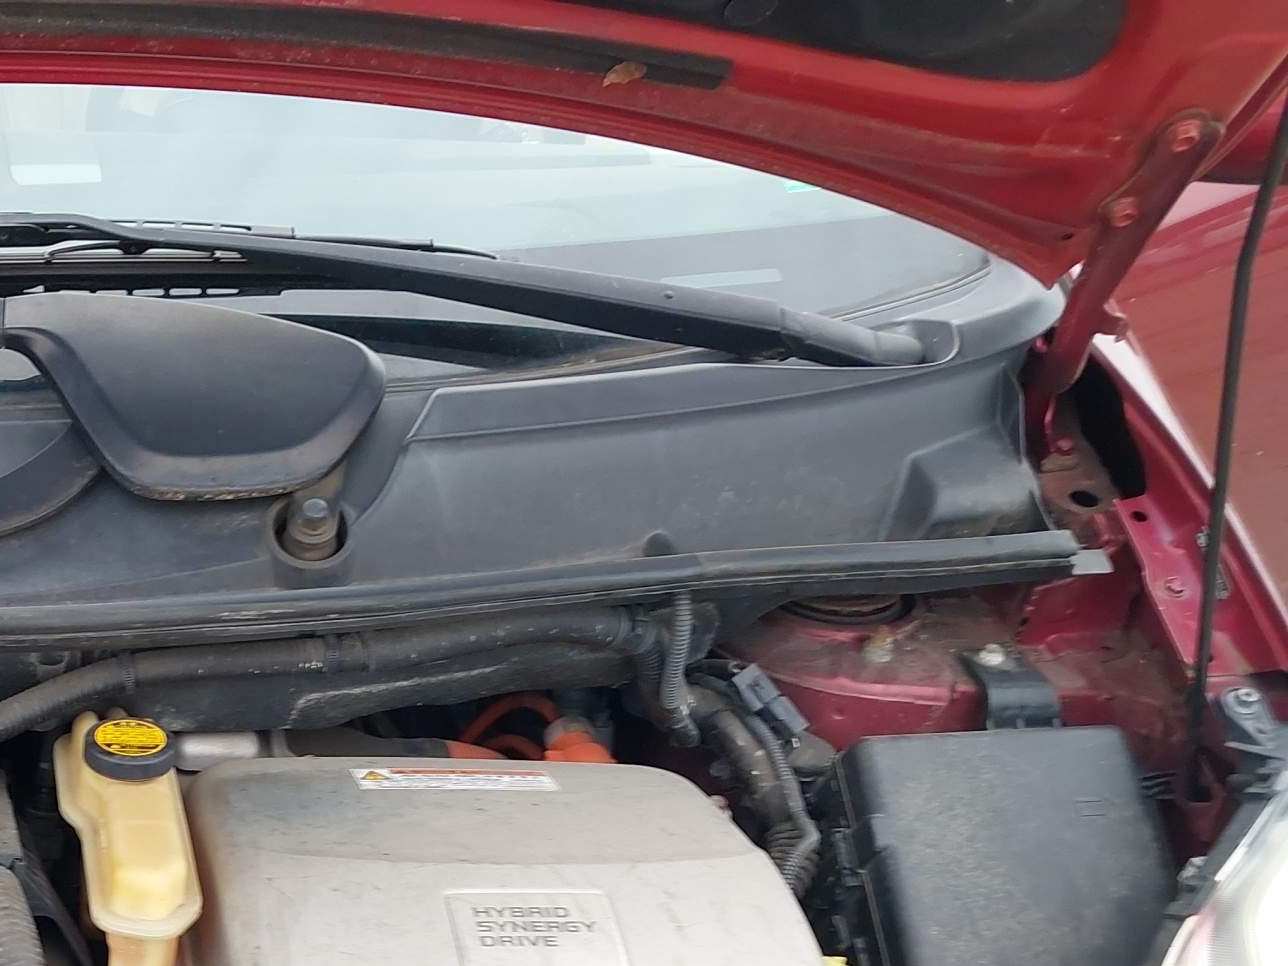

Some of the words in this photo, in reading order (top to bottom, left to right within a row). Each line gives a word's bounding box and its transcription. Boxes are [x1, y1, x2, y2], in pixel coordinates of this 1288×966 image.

[472, 906, 571, 918] HYBRID
[476, 920, 598, 933] SYNERGY
[479, 935, 561, 947] DRIVE
